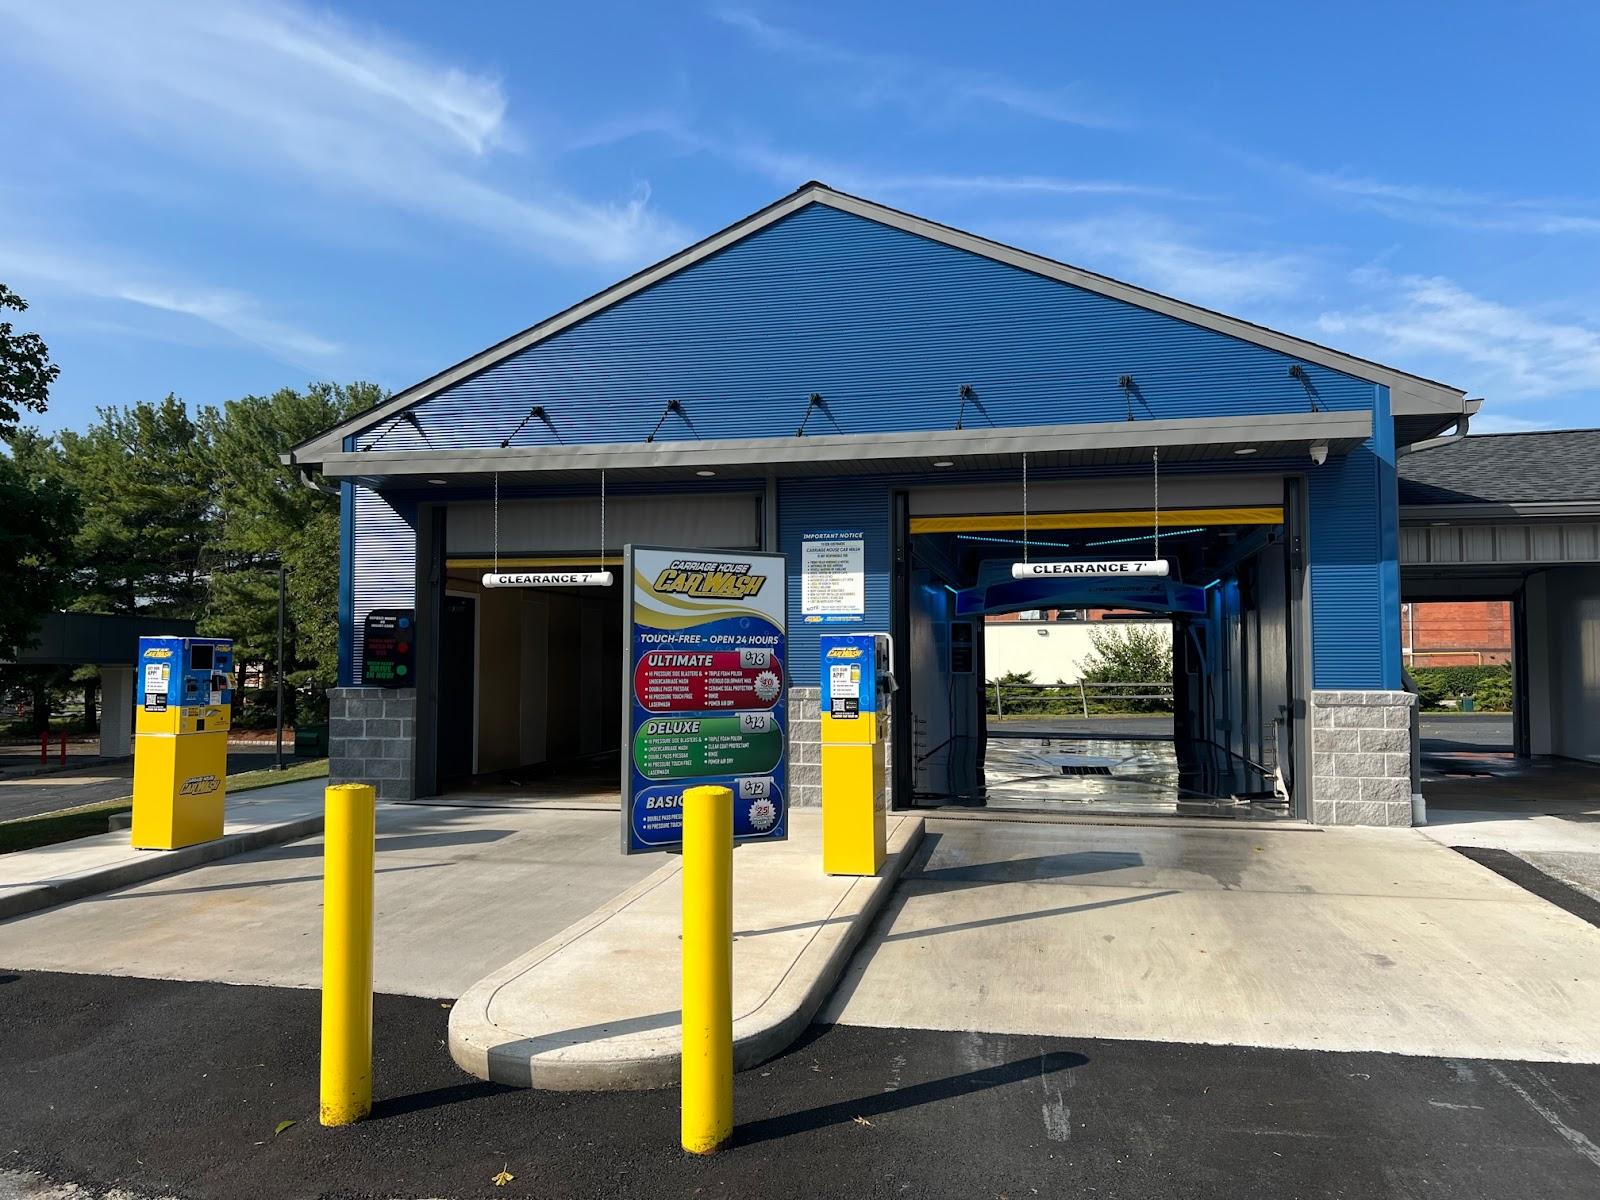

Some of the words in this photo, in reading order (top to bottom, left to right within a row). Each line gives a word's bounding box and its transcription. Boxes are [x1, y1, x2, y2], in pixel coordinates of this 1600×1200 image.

[671, 561, 716, 572] CARRIAGE
[717, 563, 750, 574] HOUSE
[1033, 563, 1129, 574] CLEARANCE
[1133, 563, 1147, 571] 7'
[499, 575, 578, 584] CLEARANCE
[640, 634, 702, 644] TOUCH-FREE
[710, 635, 736, 644] OPEN
[736, 635, 748, 644] 24
[748, 636, 779, 645] HOURS
[648, 655, 713, 667] ULTIMATE
[745, 651, 765, 665] $16
[648, 721, 700, 735] DELUXE
[745, 715, 764, 729] $14
[745, 781, 764, 795] $12
